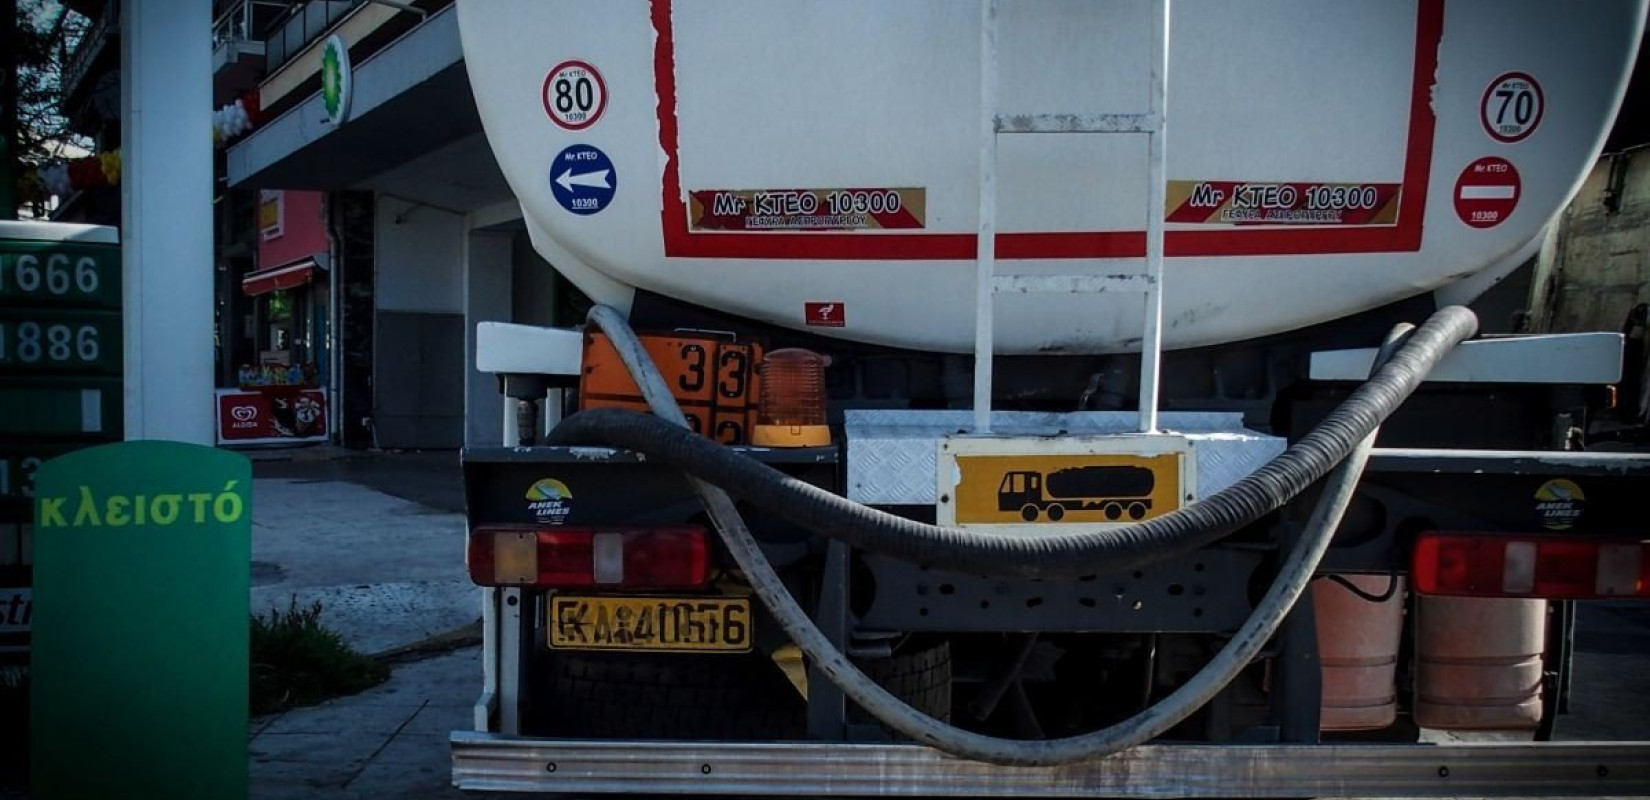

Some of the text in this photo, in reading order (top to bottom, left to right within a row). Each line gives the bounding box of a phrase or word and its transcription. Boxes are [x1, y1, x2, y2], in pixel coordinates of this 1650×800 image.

[555, 77, 593, 113] 80
[1496, 90, 1533, 125] 70
[565, 113, 587, 121] 10300
[1191, 184, 1224, 207] Mr
[1305, 186, 1377, 210] 10300
[572, 199, 599, 208] 10300
[713, 193, 746, 216] Mr
[827, 190, 901, 214] 10300
[1471, 211, 1498, 219] 10300
[40, 480, 243, 528] κλειστό
[528, 501, 563, 510] ANEK
[1535, 502, 1573, 510] ANEK
[535, 507, 570, 516] LINES
[1543, 509, 1581, 517] LINES
